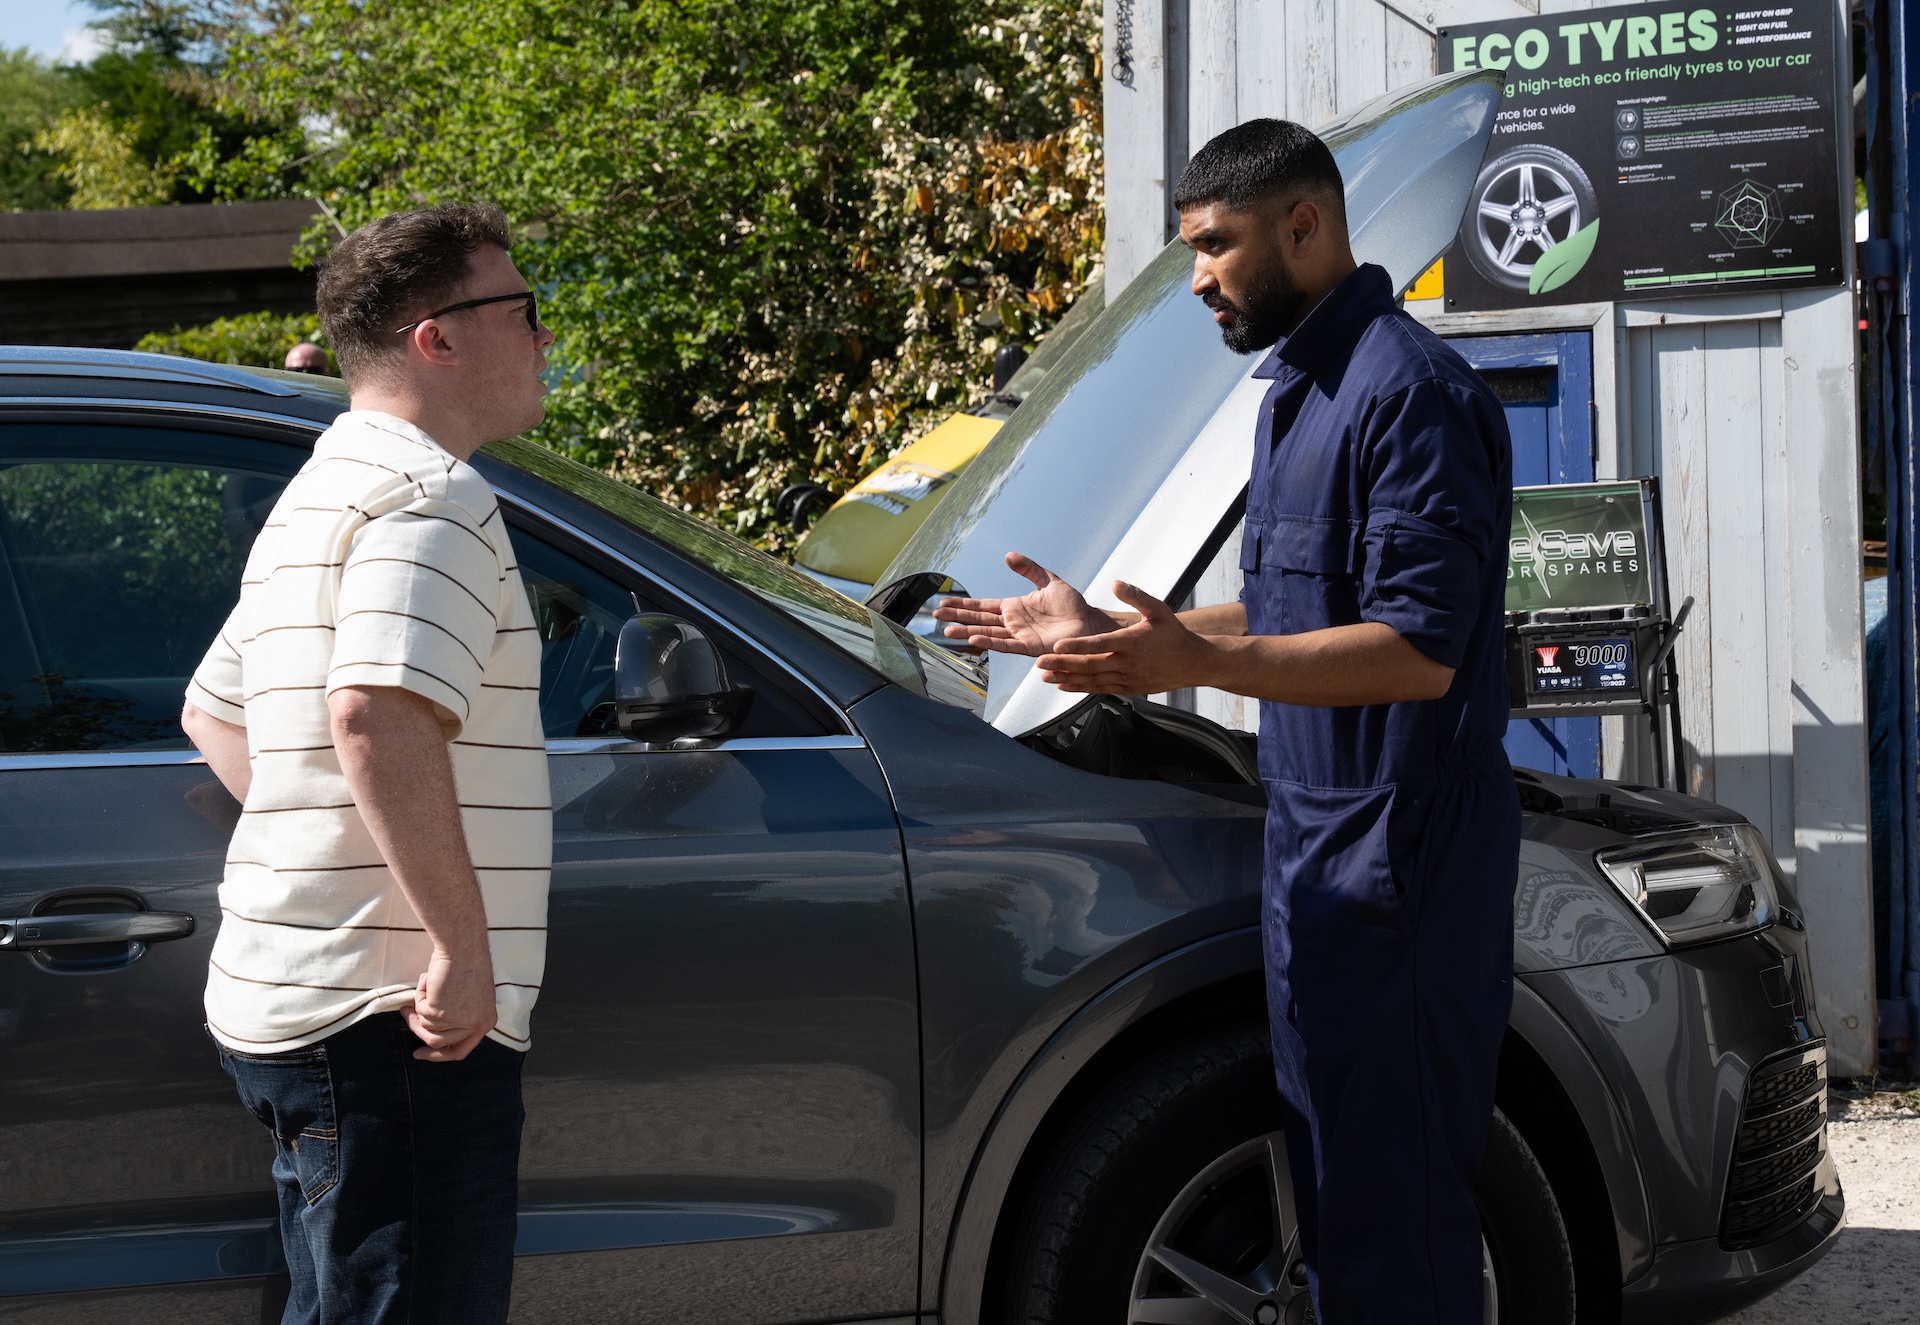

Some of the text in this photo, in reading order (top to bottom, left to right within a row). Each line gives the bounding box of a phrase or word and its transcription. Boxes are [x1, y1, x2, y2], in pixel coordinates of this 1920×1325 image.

[1735, 8, 1793, 20] HEAVY ON GRIP
[1735, 21, 1788, 32] LIGHT ON FUEL
[1453, 9, 1718, 72] ECO TYRES
[1736, 31, 1812, 45] HIGH PERFORMANCE
[1518, 74, 1590, 95] high-tech
[1594, 71, 1621, 84] eco
[1625, 63, 1682, 82] friendly
[1685, 61, 1724, 77] tyres
[1727, 59, 1743, 71] to
[1747, 56, 1781, 73] your
[1785, 53, 1812, 66] car
[1523, 107, 1538, 118] for
[1540, 107, 1548, 116] a
[1550, 103, 1576, 115] wide
[1500, 121, 1545, 134] vehicles.
[1629, 163, 1663, 172] performance:
[1540, 530, 1636, 560] Save
[1548, 559, 1638, 576] SPARES
[1575, 644, 1627, 666] 9000
[1537, 666, 1562, 674] YUASA
